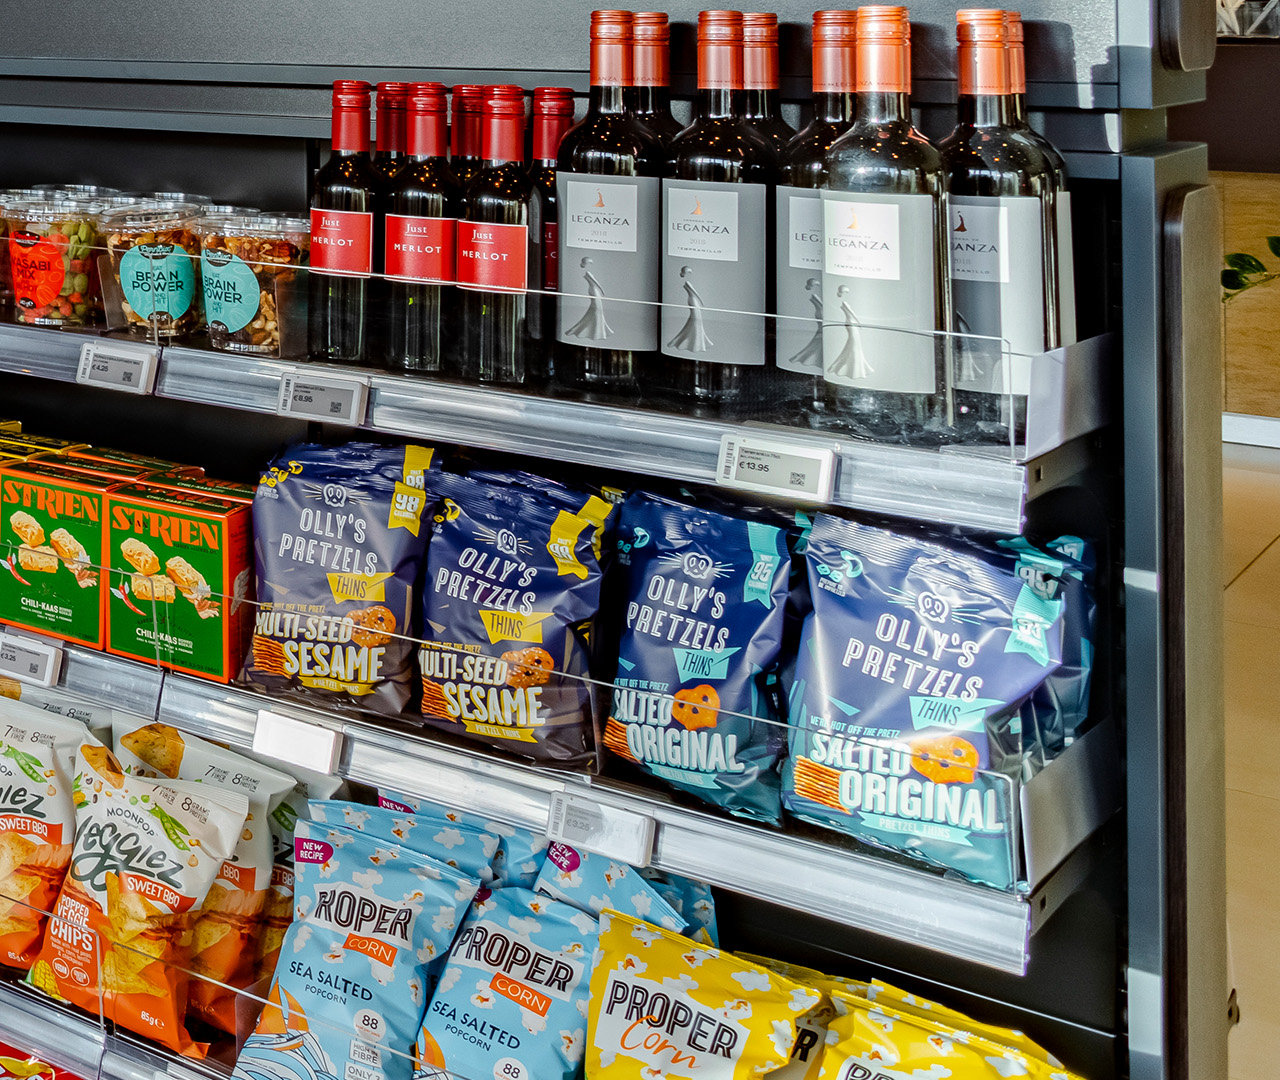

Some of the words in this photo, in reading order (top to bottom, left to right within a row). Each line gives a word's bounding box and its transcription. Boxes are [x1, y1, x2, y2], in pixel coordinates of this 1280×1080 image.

[321, 216, 340, 227] Just
[406, 223, 428, 234] Just
[571, 214, 630, 226] LEGANZA
[671, 222, 730, 235] LEGANZA
[312, 236, 354, 247] MERLOT
[472, 229, 493, 240] Just
[577, 237, 623, 245] TEMPRANILLO
[828, 237, 890, 251] LEGANZA
[394, 243, 442, 254] MERLOT
[462, 250, 509, 261] MERLOT
[677, 246, 722, 254] TEMPRANILLO
[16, 268, 36, 280] MIX
[131, 281, 184, 292] POWER
[3, 480, 99, 522] STRIEN
[395, 492, 420, 512] 98
[112, 505, 219, 550] STRIEN
[299, 508, 367, 545] OLLY'S
[279, 534, 378, 577] PRETZELS
[548, 542, 574, 562] 98
[458, 547, 539, 587] OLLY'S
[753, 560, 772, 582] 95
[336, 576, 367, 598] THINS
[435, 568, 537, 616] PRETZELS
[646, 575, 727, 619] OLLY'S
[21, 597, 59, 614] CHILI-KAAS
[490, 612, 523, 639] THINS
[627, 602, 730, 652] PRETZELS
[875, 612, 981, 668] OLLY'S
[284, 641, 386, 682] SESAME
[682, 650, 714, 678] THINS
[842, 637, 983, 703] PRETZELS
[445, 686, 546, 726] SESAME
[614, 689, 674, 726] SALTED
[917, 697, 961, 728] THINS
[501, 728, 522, 738] THINS
[830, 720, 845, 731] HOT
[847, 724, 862, 734] OFF
[863, 726, 878, 736] THE
[879, 728, 901, 739] PRETZ
[626, 722, 745, 774] ORIGINAL
[811, 731, 912, 778] SALTED
[231, 774, 242, 785] 8
[181, 797, 193, 811] 8
[383, 800, 406, 812] NEW
[840, 772, 1004, 831] ORIGINAL
[31, 822, 48, 836] BBQ
[106, 806, 156, 837] MOONPOP
[878, 817, 918, 836] PRETZEL
[920, 823, 951, 839] THINS
[302, 840, 323, 852] NEW
[126, 877, 158, 902] SWEET
[159, 887, 180, 907] BBQ
[61, 895, 90, 917] POPPED
[50, 919, 93, 952] CHIPS
[347, 936, 394, 963] CORN
[450, 926, 575, 993] PROPER
[289, 960, 315, 981] SEA
[318, 970, 374, 1002] SALTED
[304, 983, 348, 1006] POPCORN
[495, 977, 547, 1012] CORN
[362, 1014, 379, 1029] 88
[433, 1001, 457, 1022] SEA
[460, 1013, 521, 1050] SALTED
[607, 977, 738, 1062] PROPER
[444, 1023, 492, 1052] POPCORN
[620, 1015, 703, 1070] Corn
[352, 1049, 378, 1064] FIBRE
[502, 1063, 521, 1080] 88
